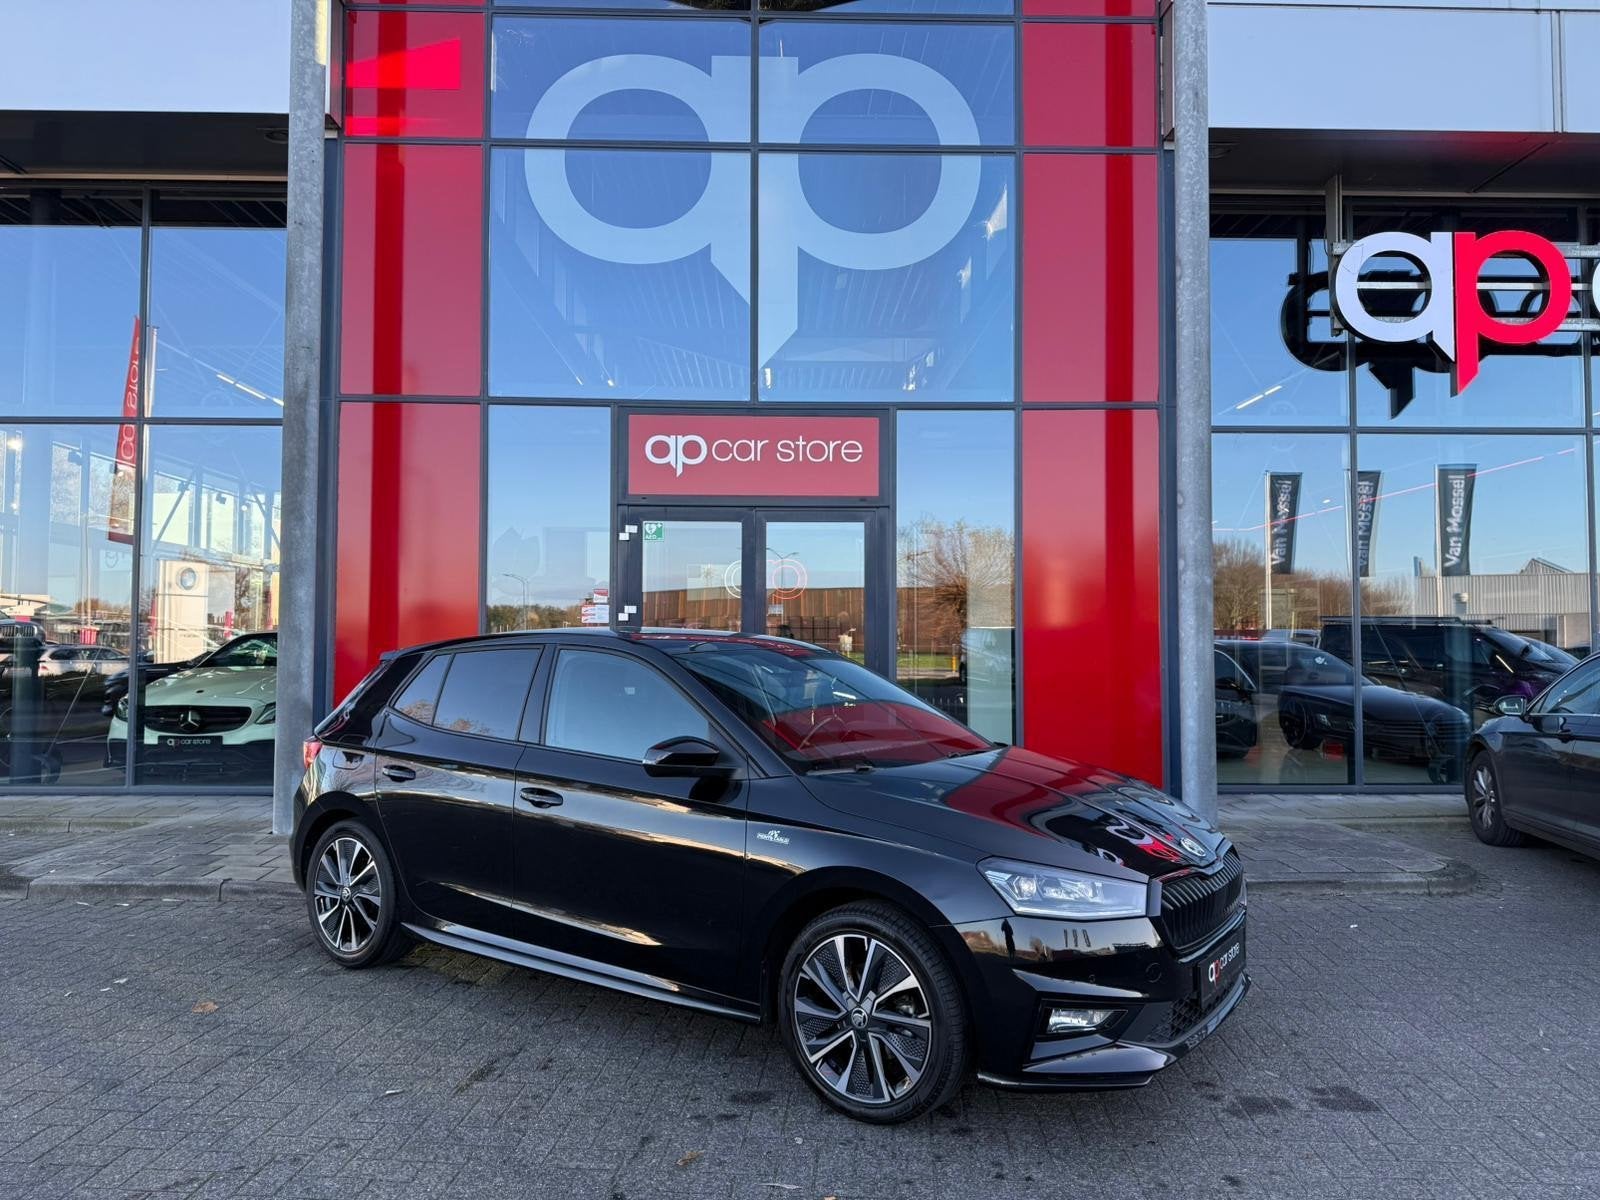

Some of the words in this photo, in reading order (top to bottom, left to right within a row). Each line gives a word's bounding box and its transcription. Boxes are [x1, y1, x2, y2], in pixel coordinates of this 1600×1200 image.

[525, 53, 981, 369] ap
[1335, 230, 1572, 395] ap
[645, 435, 708, 477] ap
[711, 439, 769, 462] car
[776, 435, 863, 463] store
[1447, 475, 1466, 534] Mossel
[1271, 537, 1287, 565] Van
[1444, 537, 1462, 567] Van
